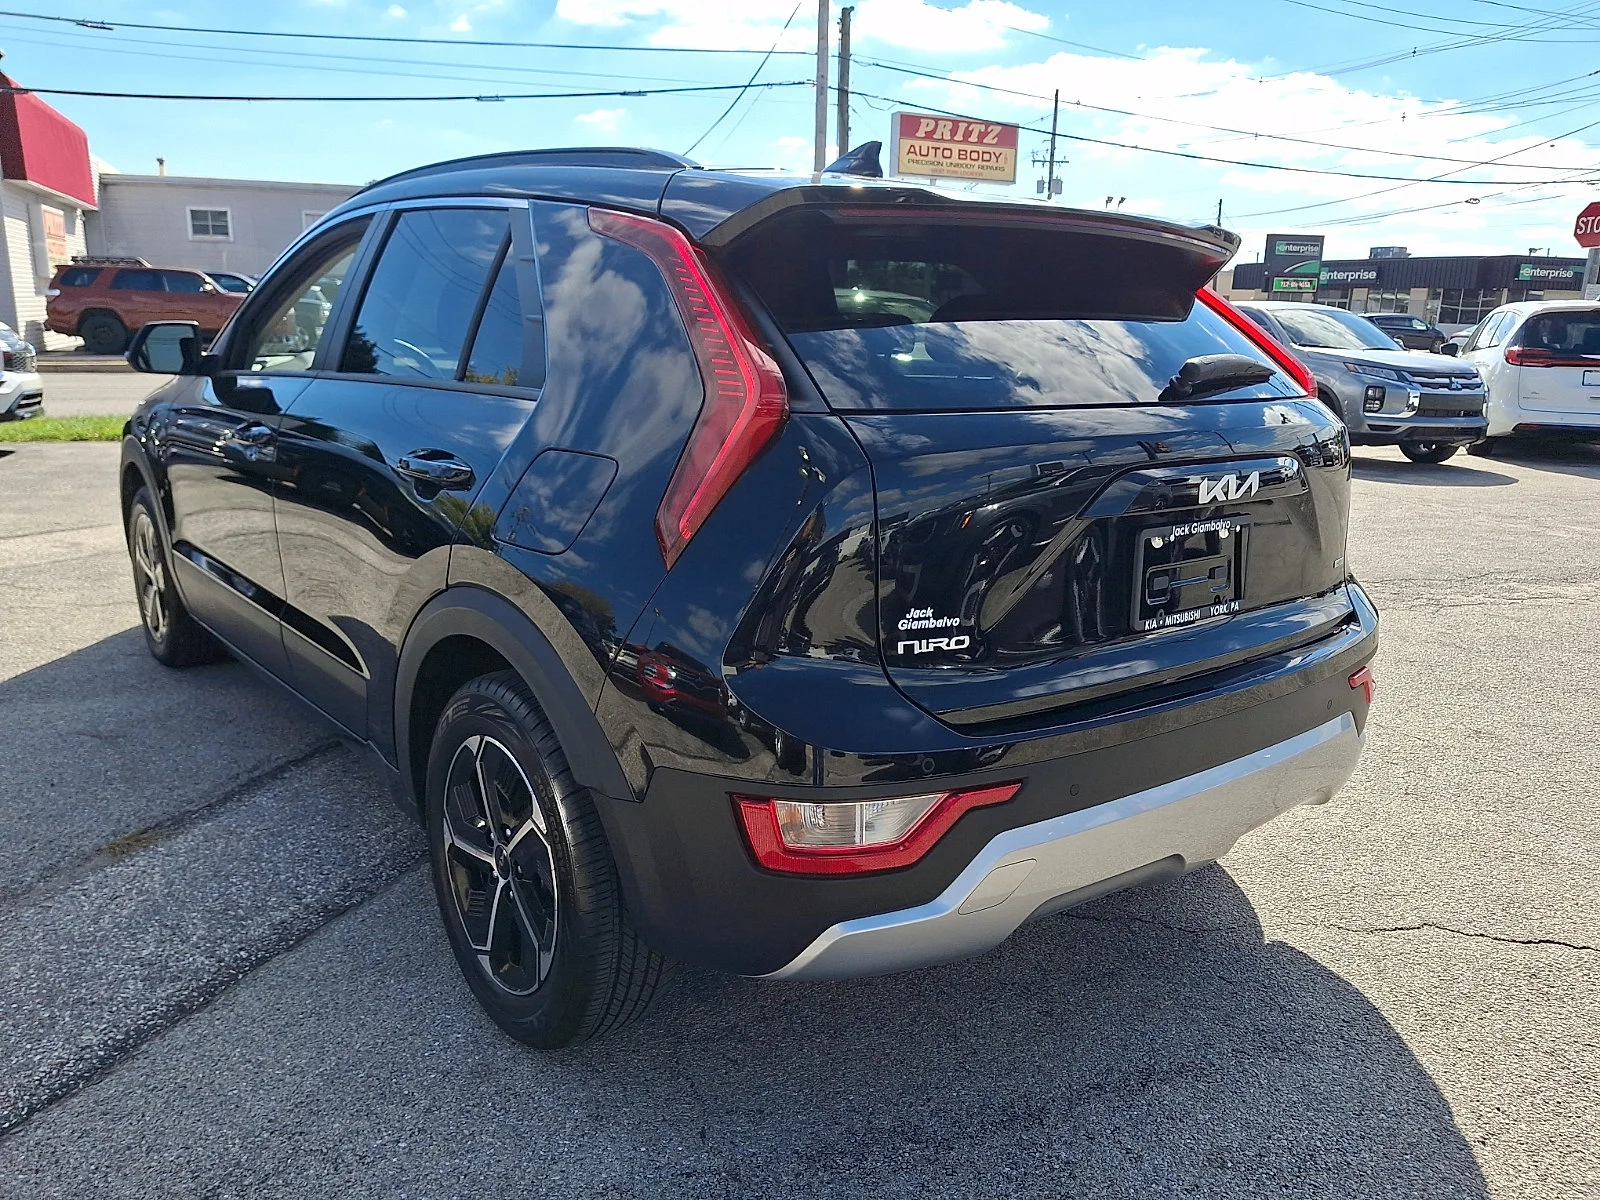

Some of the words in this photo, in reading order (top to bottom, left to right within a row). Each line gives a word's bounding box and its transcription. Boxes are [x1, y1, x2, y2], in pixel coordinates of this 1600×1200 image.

[915, 118, 1002, 144] PRITZ
[906, 144, 953, 159] AUTO
[958, 149, 1002, 163] BODY
[907, 158, 944, 168] PRECISION
[1278, 244, 1319, 253] enterprise
[1320, 268, 1377, 282] enterprise
[1521, 268, 1574, 279] enterprise
[1170, 524, 1190, 542] Jack
[1191, 519, 1231, 534] Giambalvo
[906, 606, 934, 619] Jack
[1144, 619, 1158, 631] KIA
[1164, 609, 1201, 626] MITSUBISHI
[1230, 601, 1240, 613] PA
[898, 616, 960, 630] Giambalvo
[897, 635, 970, 655] NIRO
